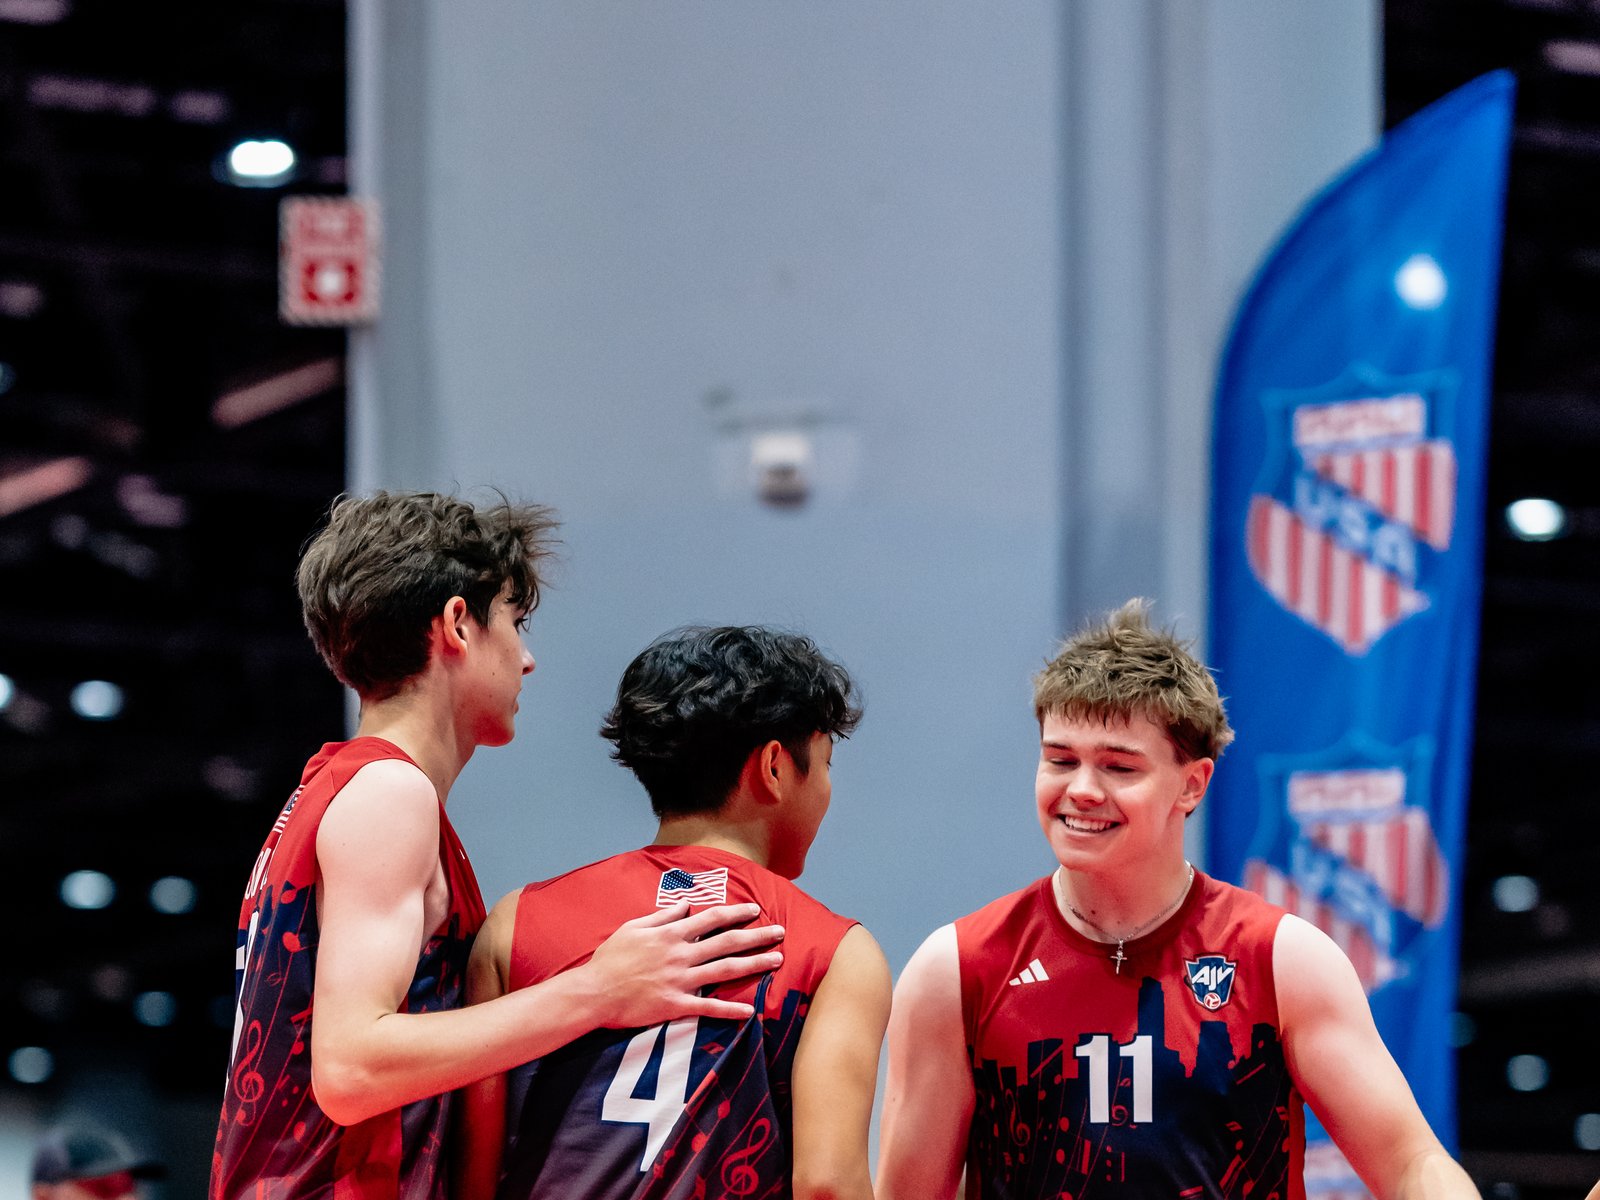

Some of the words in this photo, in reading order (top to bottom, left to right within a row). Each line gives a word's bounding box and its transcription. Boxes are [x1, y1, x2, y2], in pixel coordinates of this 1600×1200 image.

[1191, 965, 1234, 991] AJV
[601, 1014, 700, 1172] 4
[1075, 1035, 1153, 1123] 11
